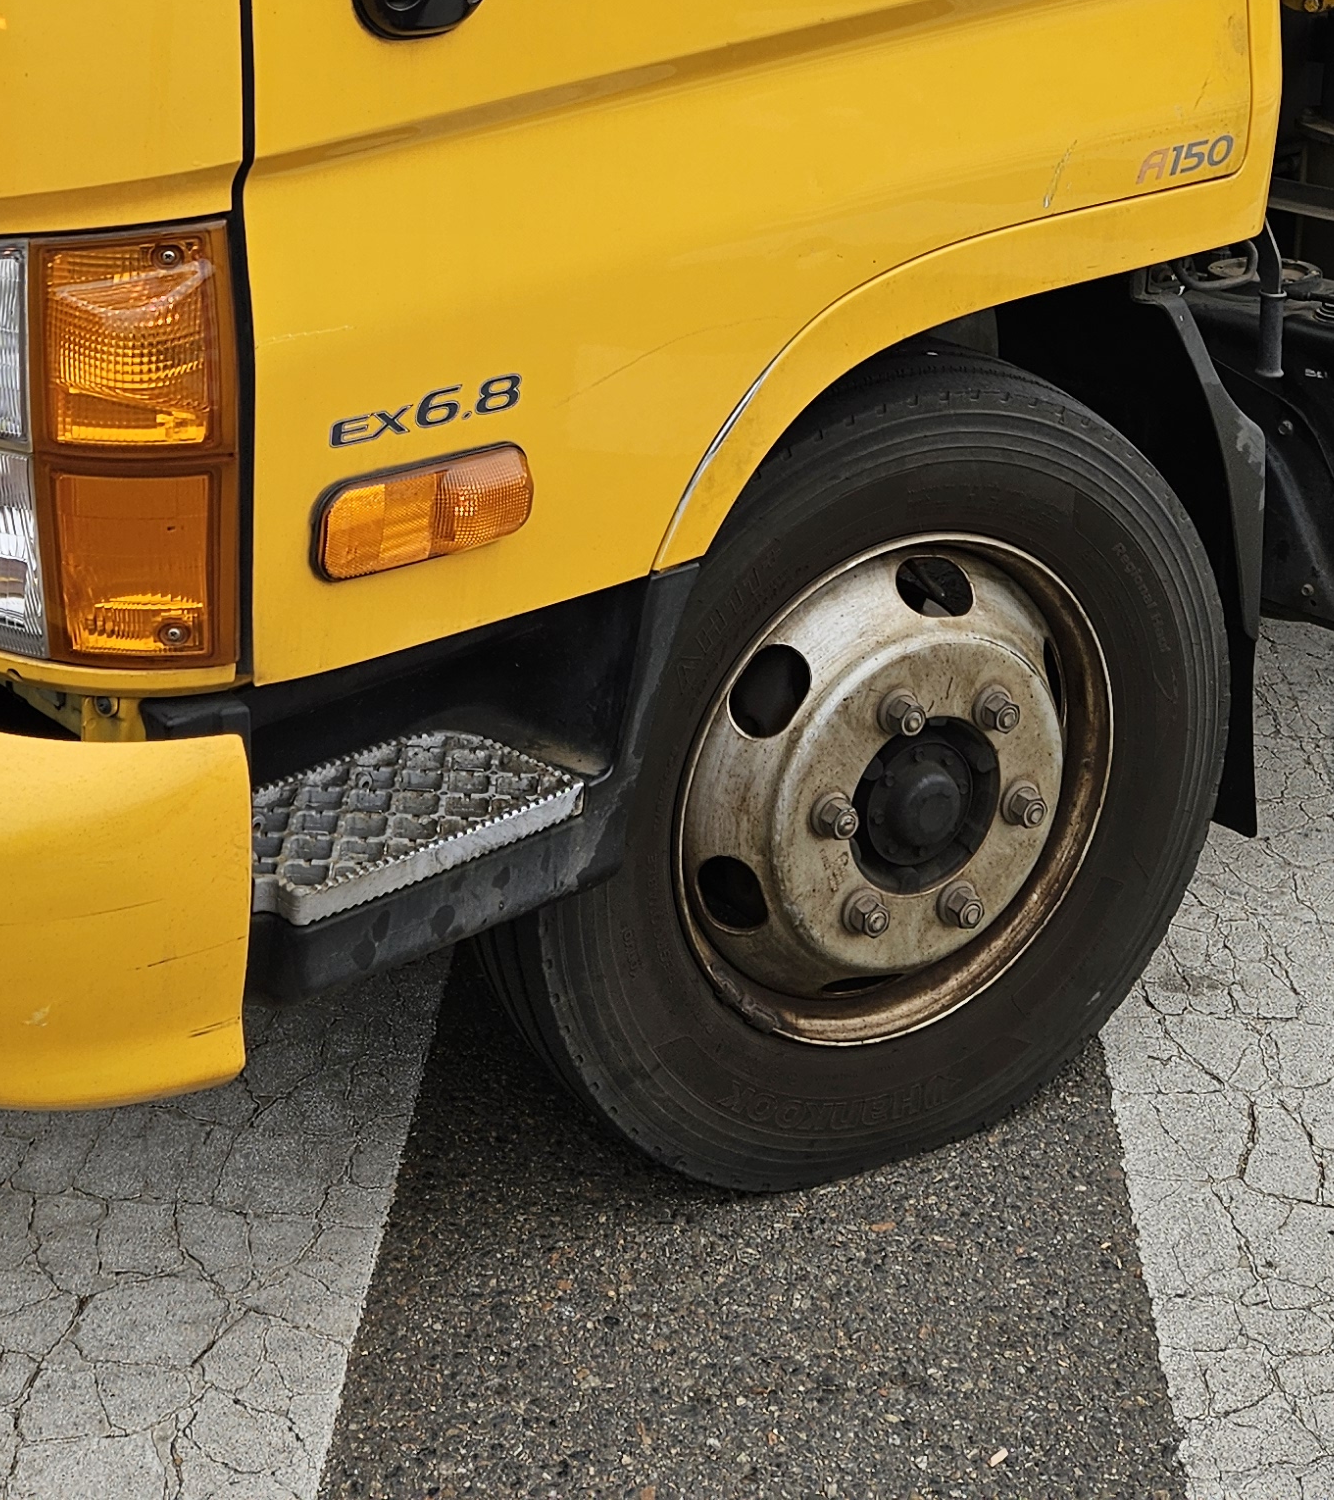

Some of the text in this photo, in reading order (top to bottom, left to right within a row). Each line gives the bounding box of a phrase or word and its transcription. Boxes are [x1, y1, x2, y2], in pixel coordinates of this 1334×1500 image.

[1135, 134, 1234, 185] A150
[329, 373, 522, 448] EX6.8
[1111, 542, 1158, 610] Regional
